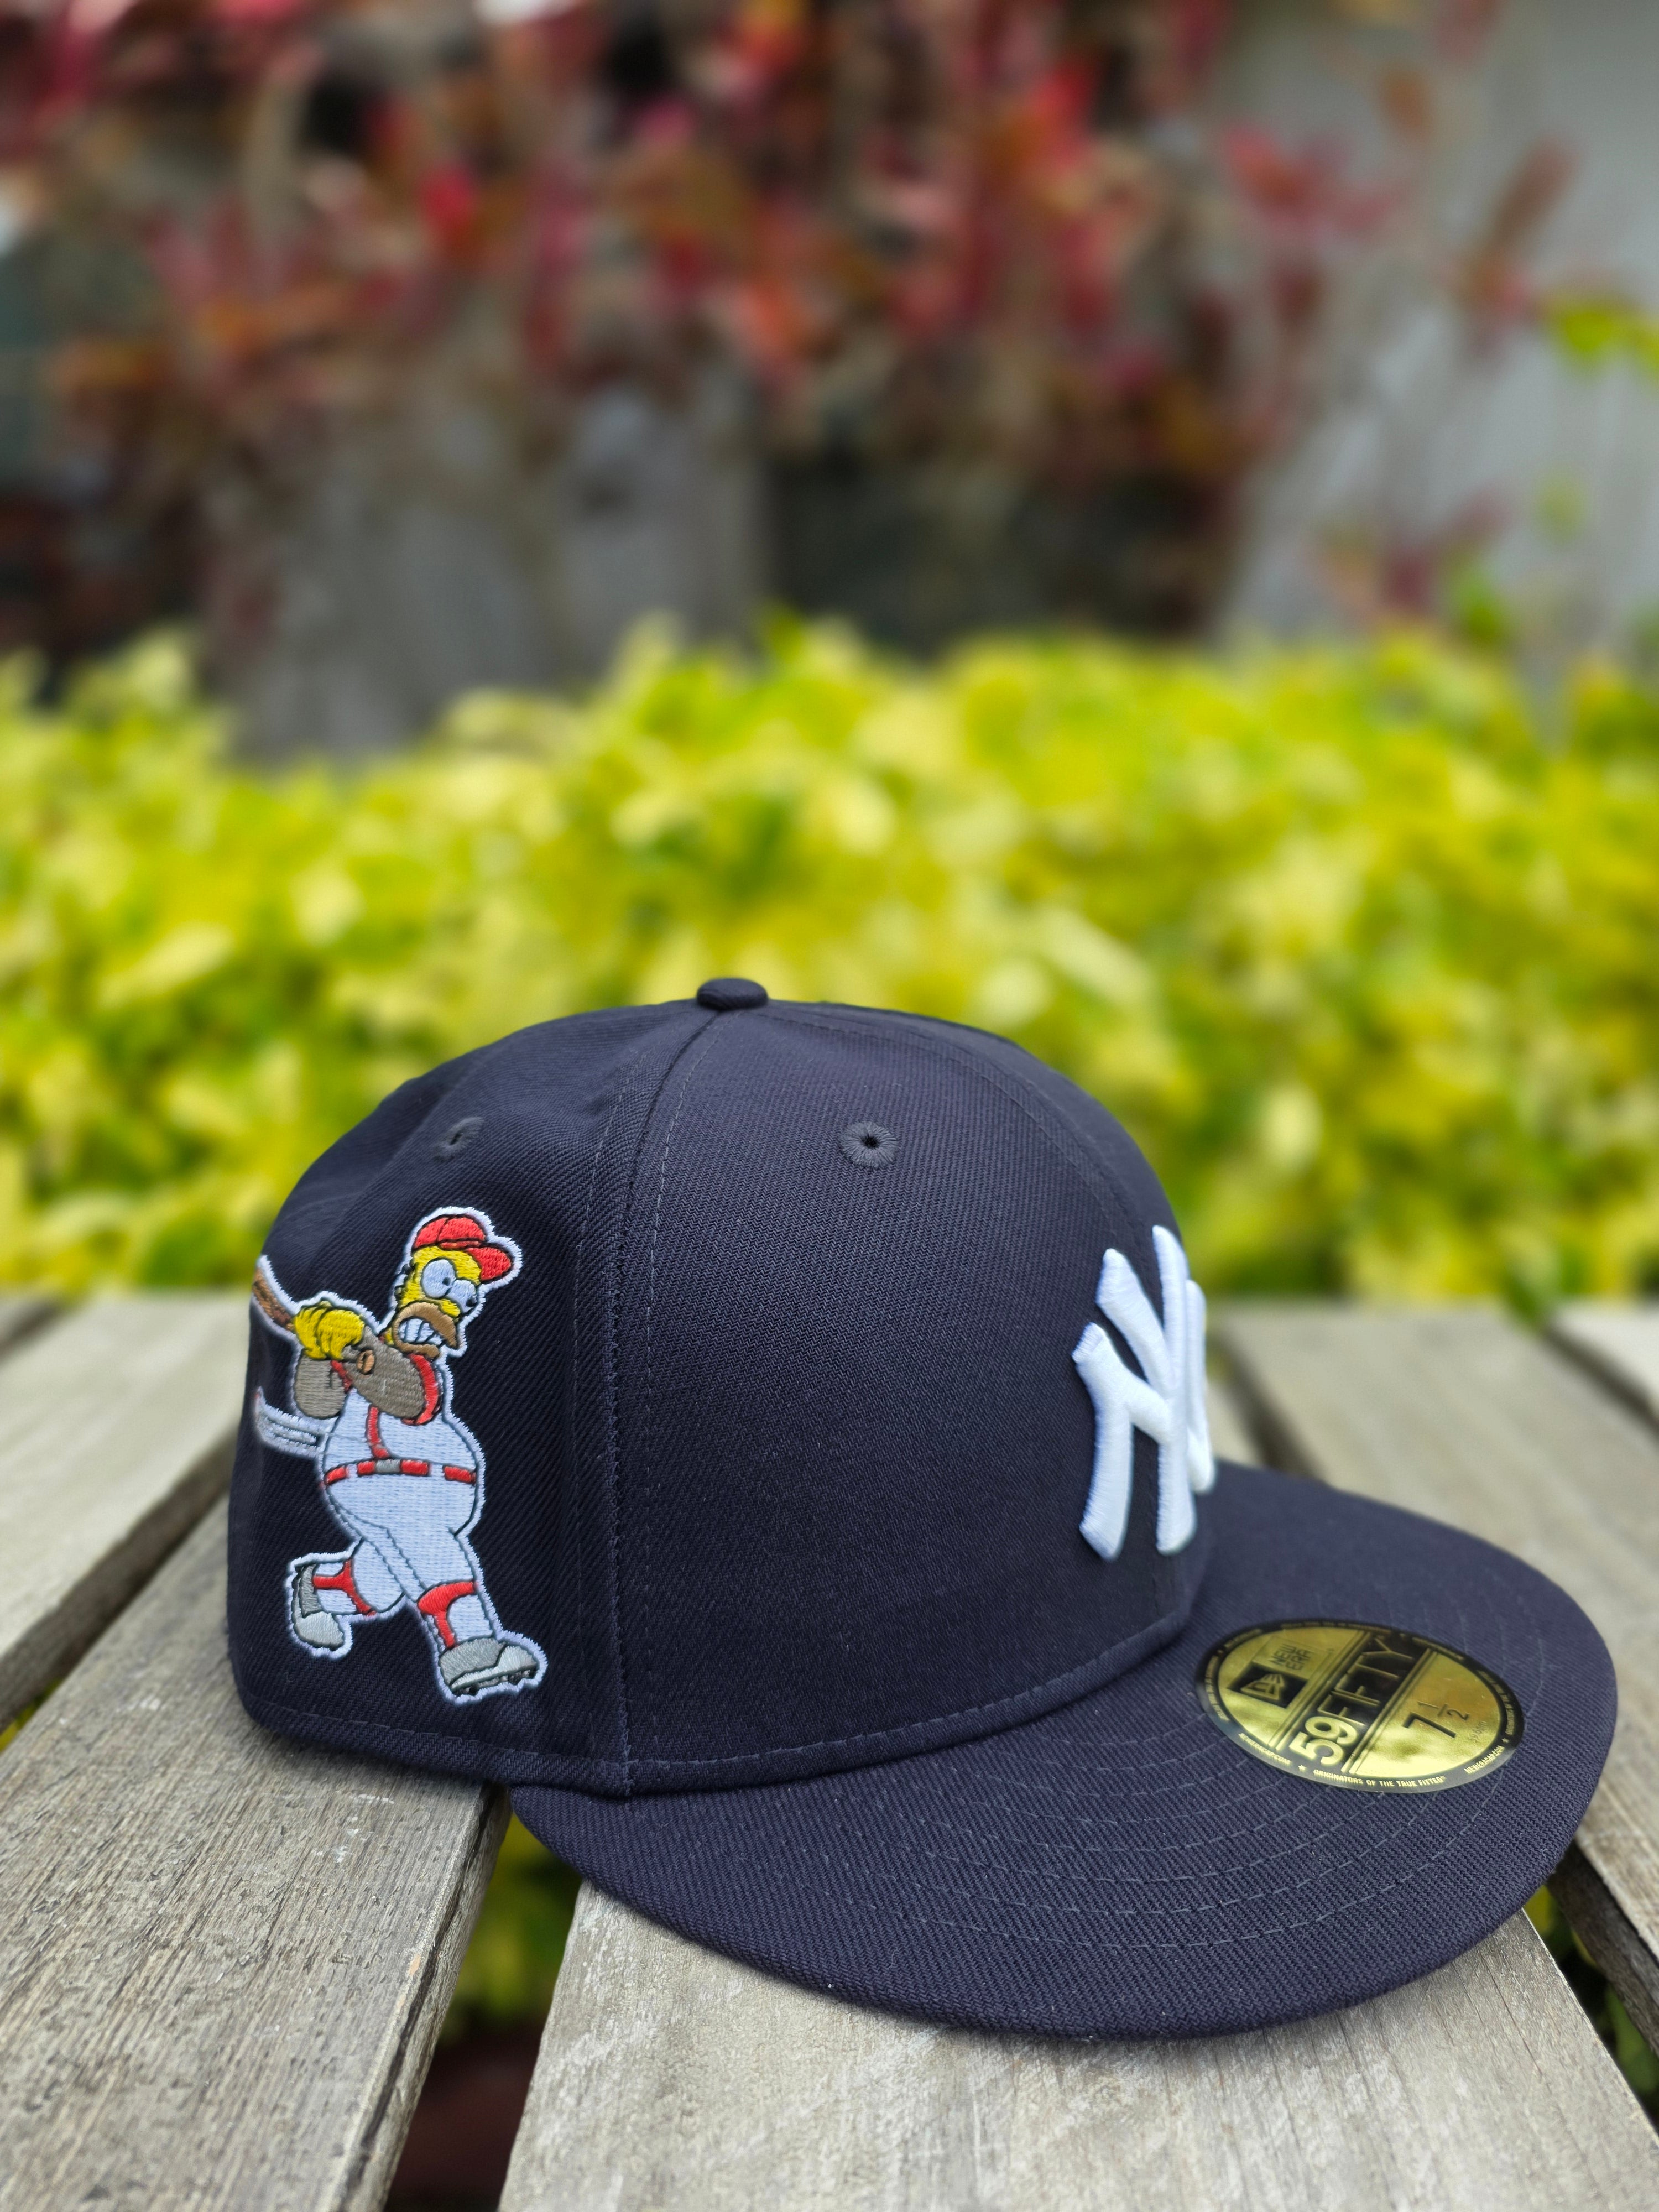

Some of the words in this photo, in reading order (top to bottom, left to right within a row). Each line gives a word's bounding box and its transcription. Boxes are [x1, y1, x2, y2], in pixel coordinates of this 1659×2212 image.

[1072, 1225, 1215, 1561] NY
[1269, 1644, 1296, 1666] NEW
[1285, 1648, 1314, 1670] ERA
[1290, 1637, 1413, 1765] 59FIFTY
[1238, 1733, 1292, 1765] NEWERACAP.COM
[1464, 1745, 1504, 1773] NEWERACAP.COM
[1313, 1769, 1363, 1785] ORIGINATORS
